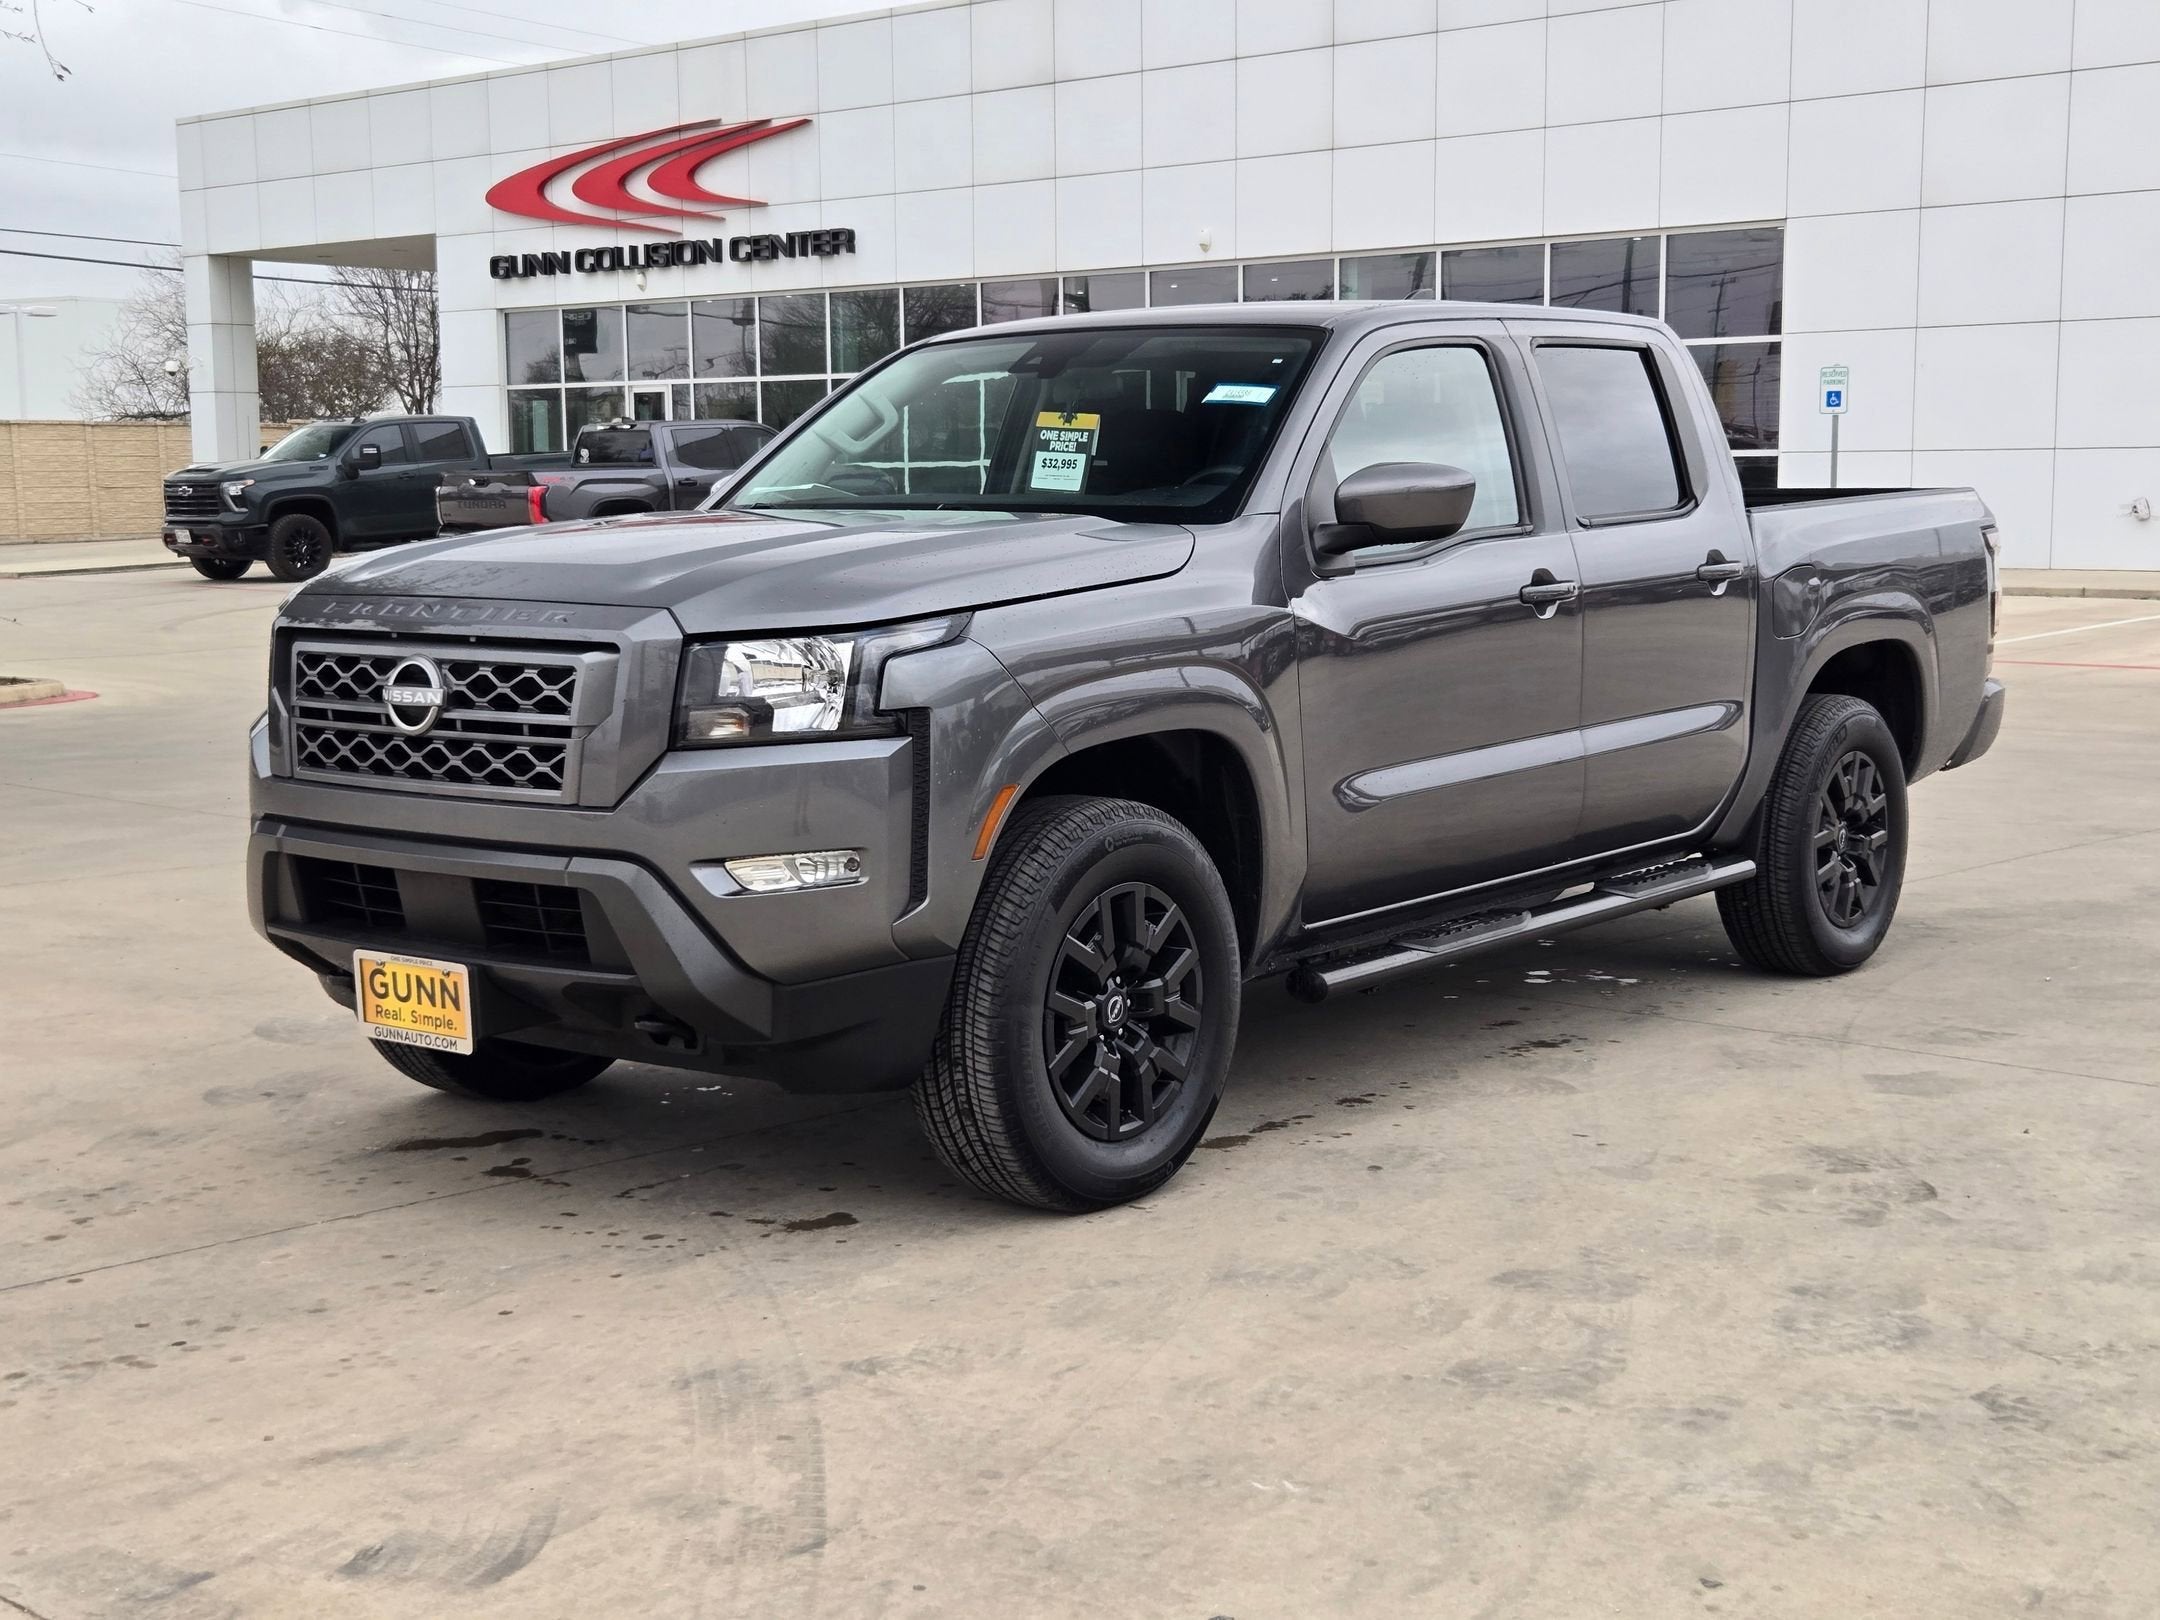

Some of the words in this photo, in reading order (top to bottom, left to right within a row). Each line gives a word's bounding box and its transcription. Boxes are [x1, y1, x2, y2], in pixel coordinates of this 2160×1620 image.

[489, 250, 571, 280] GUNN
[574, 238, 723, 273] COLLISION
[729, 227, 856, 262] CENTER
[1040, 429, 1059, 440] ONE
[1060, 431, 1089, 442] SIMPLE
[1049, 441, 1077, 452] PRICE!
[1041, 458, 1078, 471] $32,995
[457, 500, 507, 509] TUNDRA
[323, 601, 576, 624] FRONTIER
[383, 687, 442, 705] NISSAN
[369, 967, 461, 1012] GUNN
[375, 1004, 406, 1022] Real.
[374, 1026, 458, 1051] GUNNAUTO.COM
